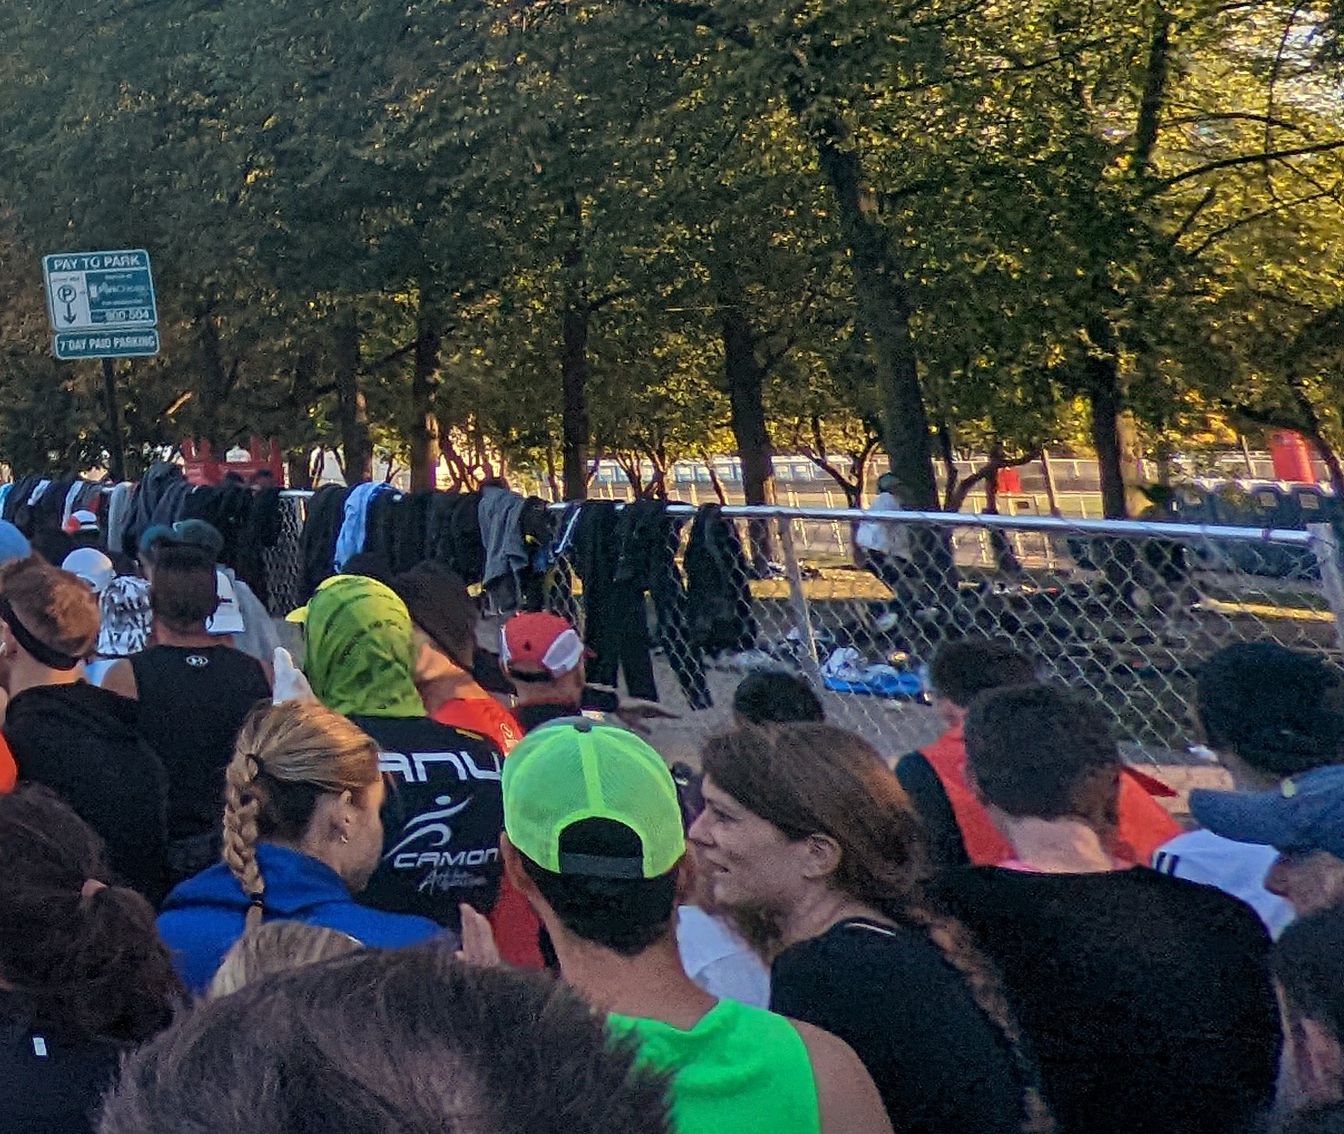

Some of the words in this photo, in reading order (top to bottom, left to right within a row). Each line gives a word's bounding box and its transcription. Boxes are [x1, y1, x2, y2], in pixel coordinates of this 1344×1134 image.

[53, 259, 78, 270] PAY
[81, 256, 100, 269] TO
[104, 254, 140, 267] PARK
[68, 339, 87, 351] DAY
[88, 337, 112, 349] PAID
[113, 335, 155, 348] PARKING
